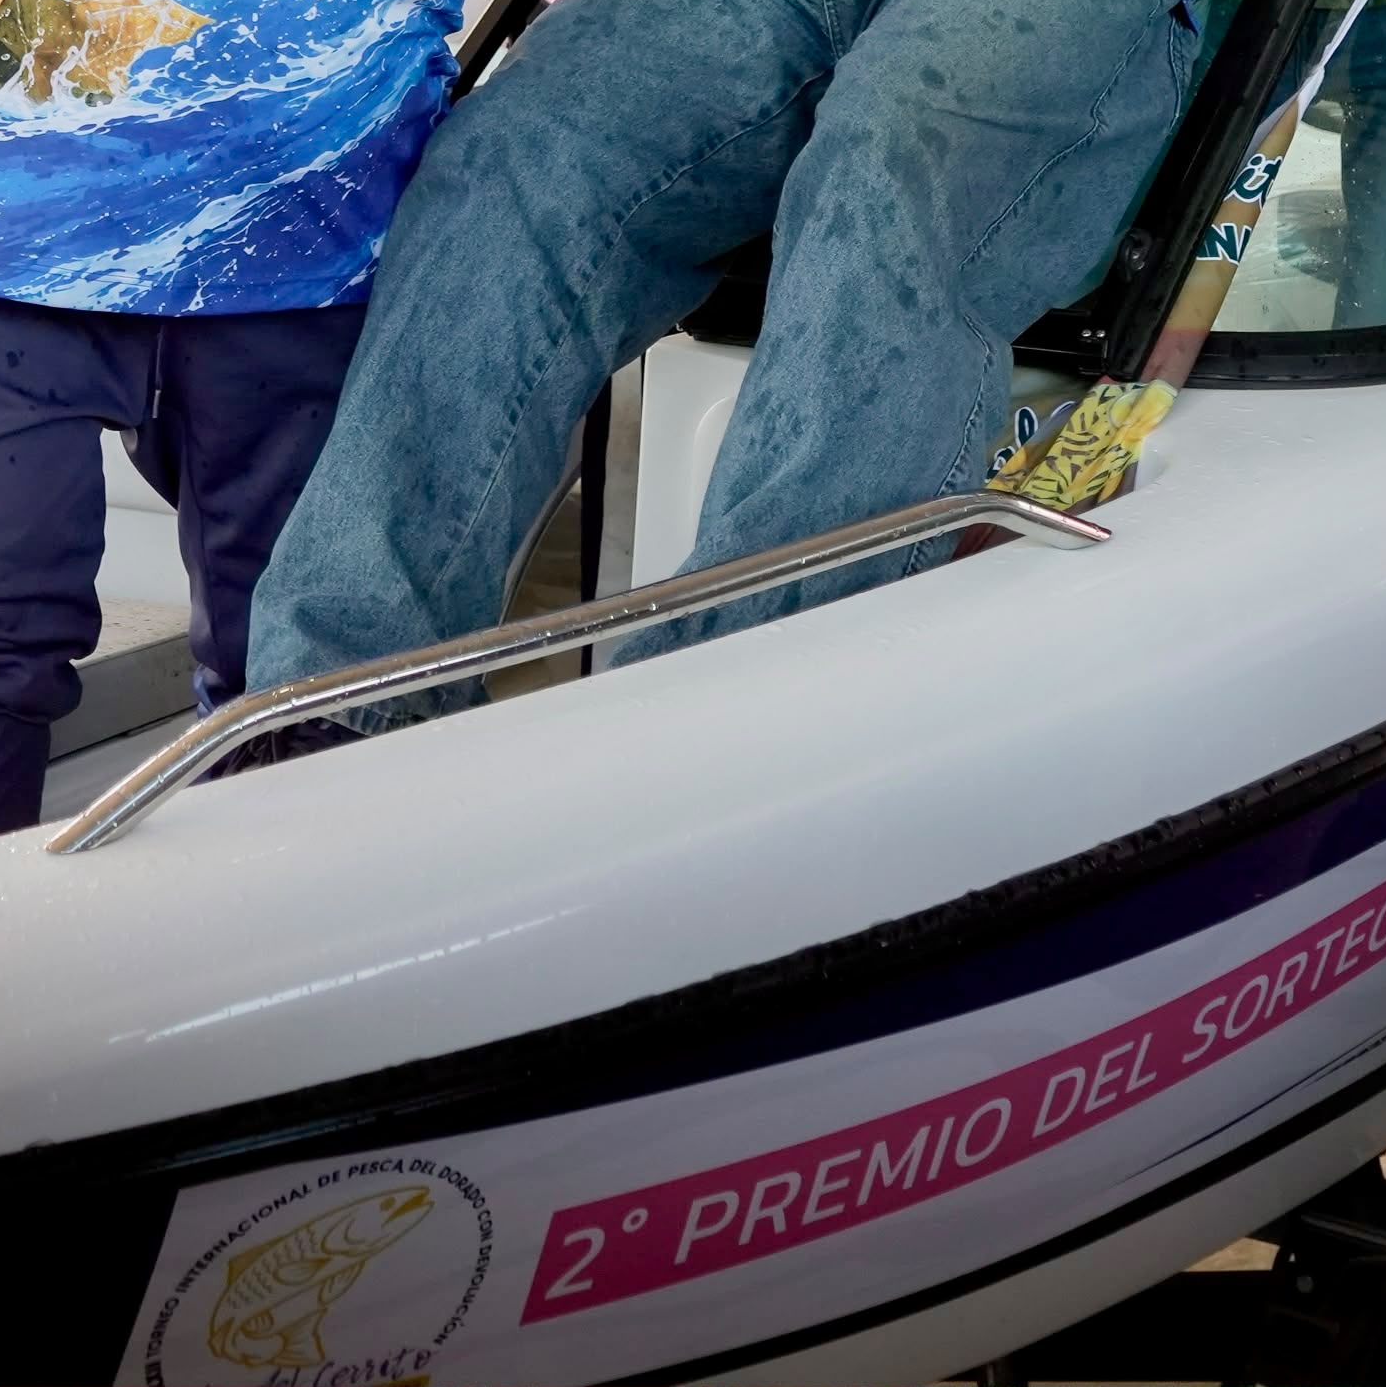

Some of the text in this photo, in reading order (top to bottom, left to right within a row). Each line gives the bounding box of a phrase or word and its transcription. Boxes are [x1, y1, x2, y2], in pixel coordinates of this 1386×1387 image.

[673, 1097, 1013, 1267] PREMIO
[1032, 1031, 1157, 1140] DEL
[146, 1297, 180, 1362] TORNEO
[176, 1183, 313, 1294] INTERNACIONAL
[317, 1169, 341, 1190] DE
[347, 1158, 404, 1179] PESCA
[408, 1158, 437, 1176] DEL
[438, 1165, 486, 1210] DORADO
[477, 1210, 494, 1242] CON
